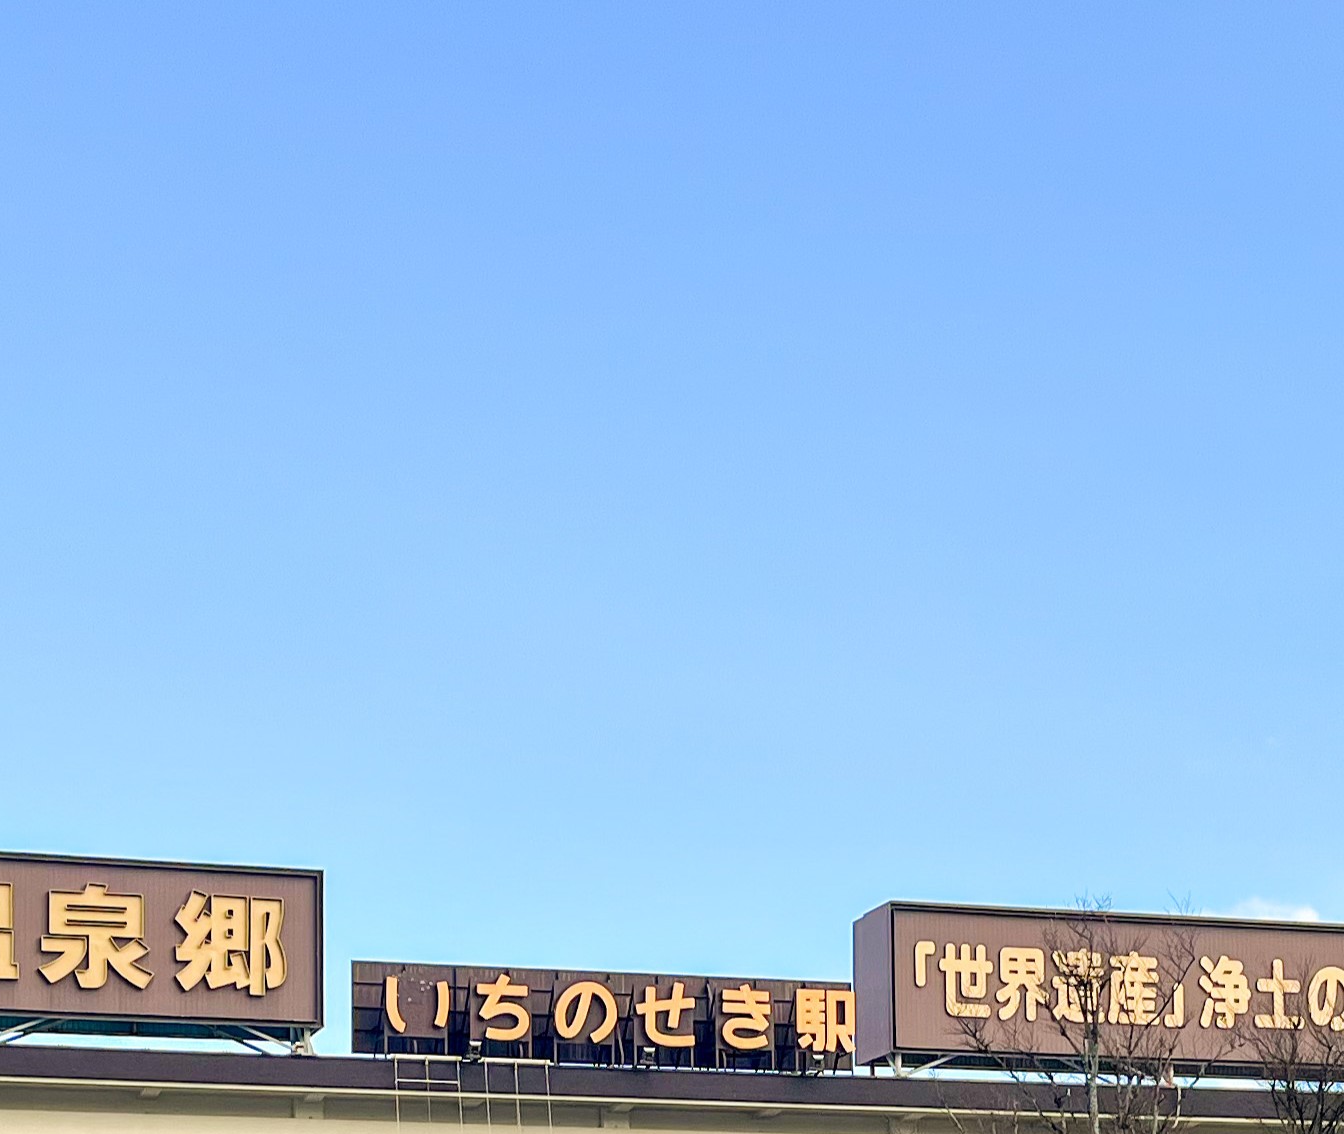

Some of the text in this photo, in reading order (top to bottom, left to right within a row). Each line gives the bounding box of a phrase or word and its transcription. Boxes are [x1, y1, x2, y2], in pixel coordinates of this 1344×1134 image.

[385, 973, 856, 1053] いちのせき駅
